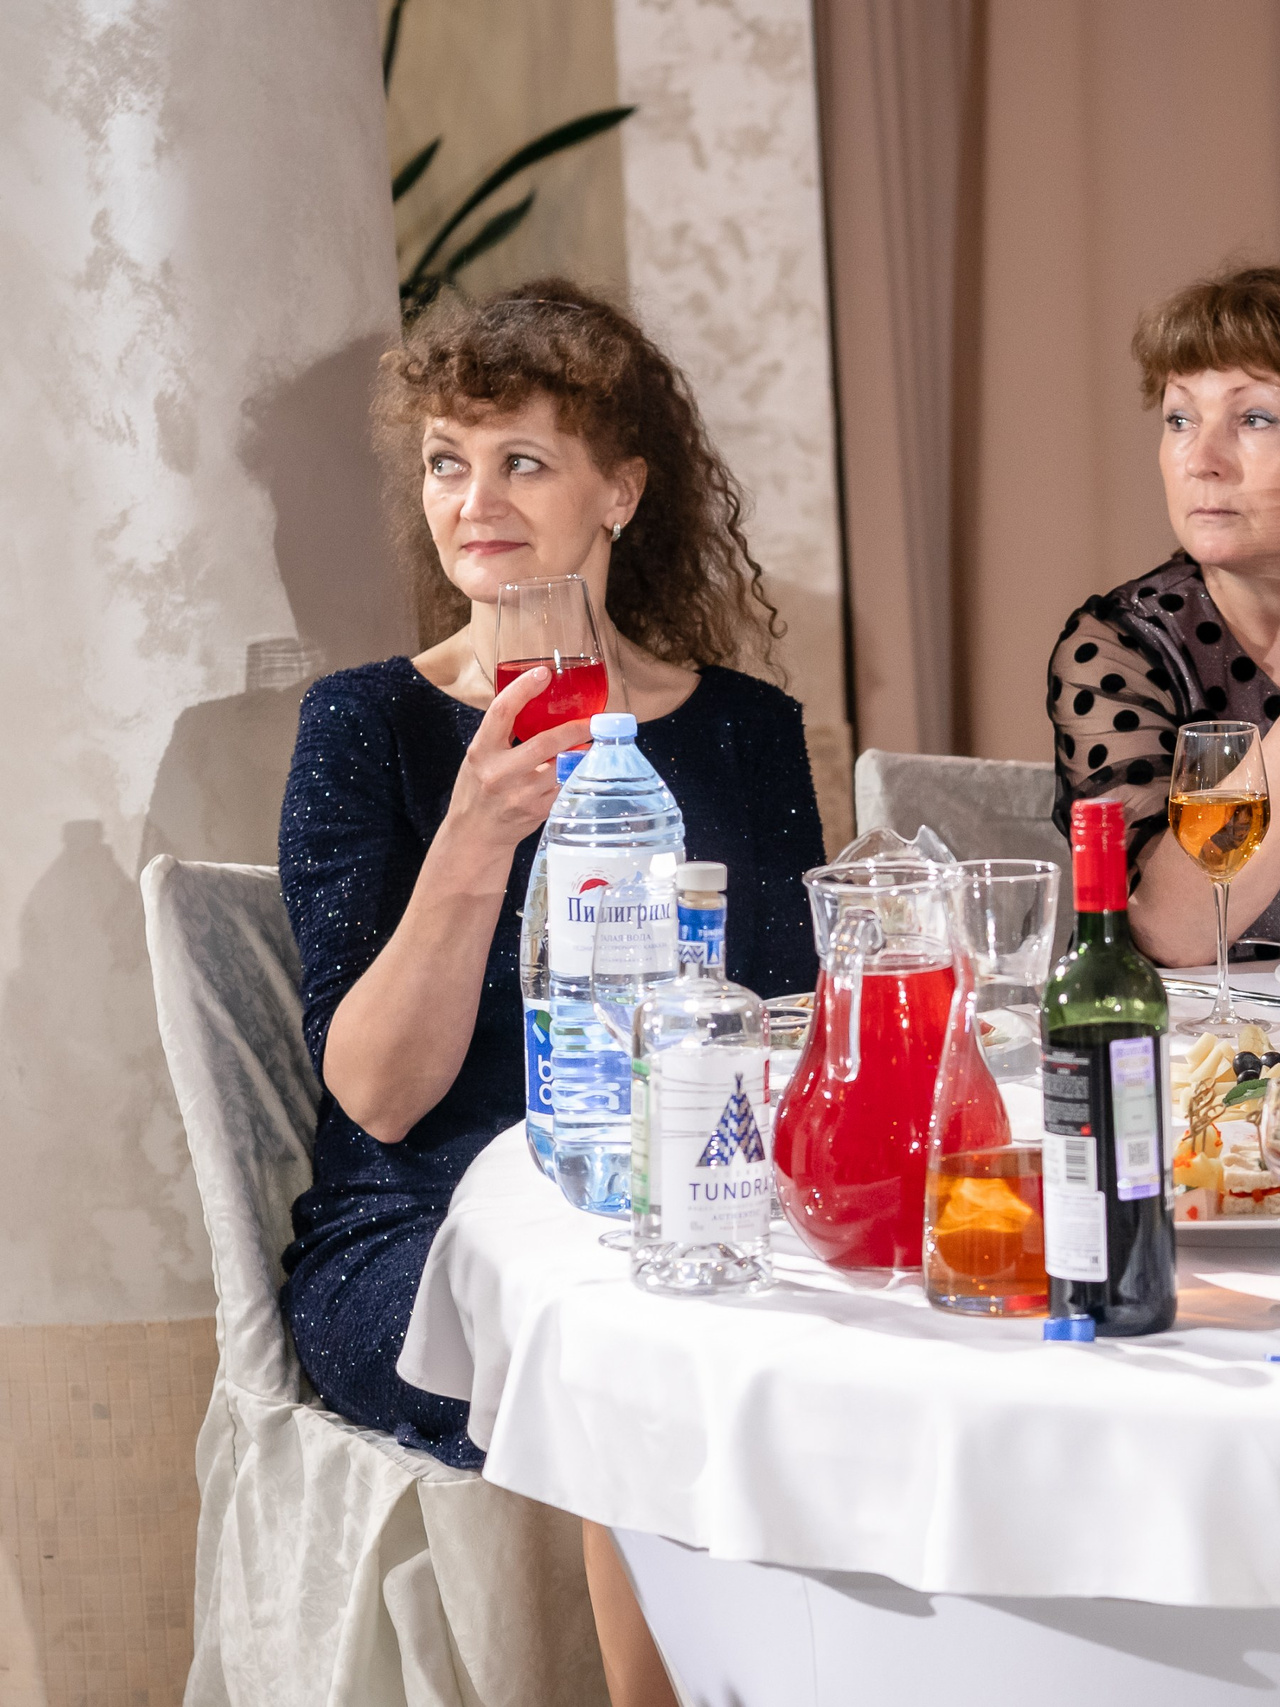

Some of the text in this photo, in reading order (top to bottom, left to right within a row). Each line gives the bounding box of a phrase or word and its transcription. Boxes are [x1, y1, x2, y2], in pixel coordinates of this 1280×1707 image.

[567, 897, 671, 930] Пилигрим
[626, 933, 652, 942] ВОДА
[688, 1177, 769, 1201] TUNDRA
